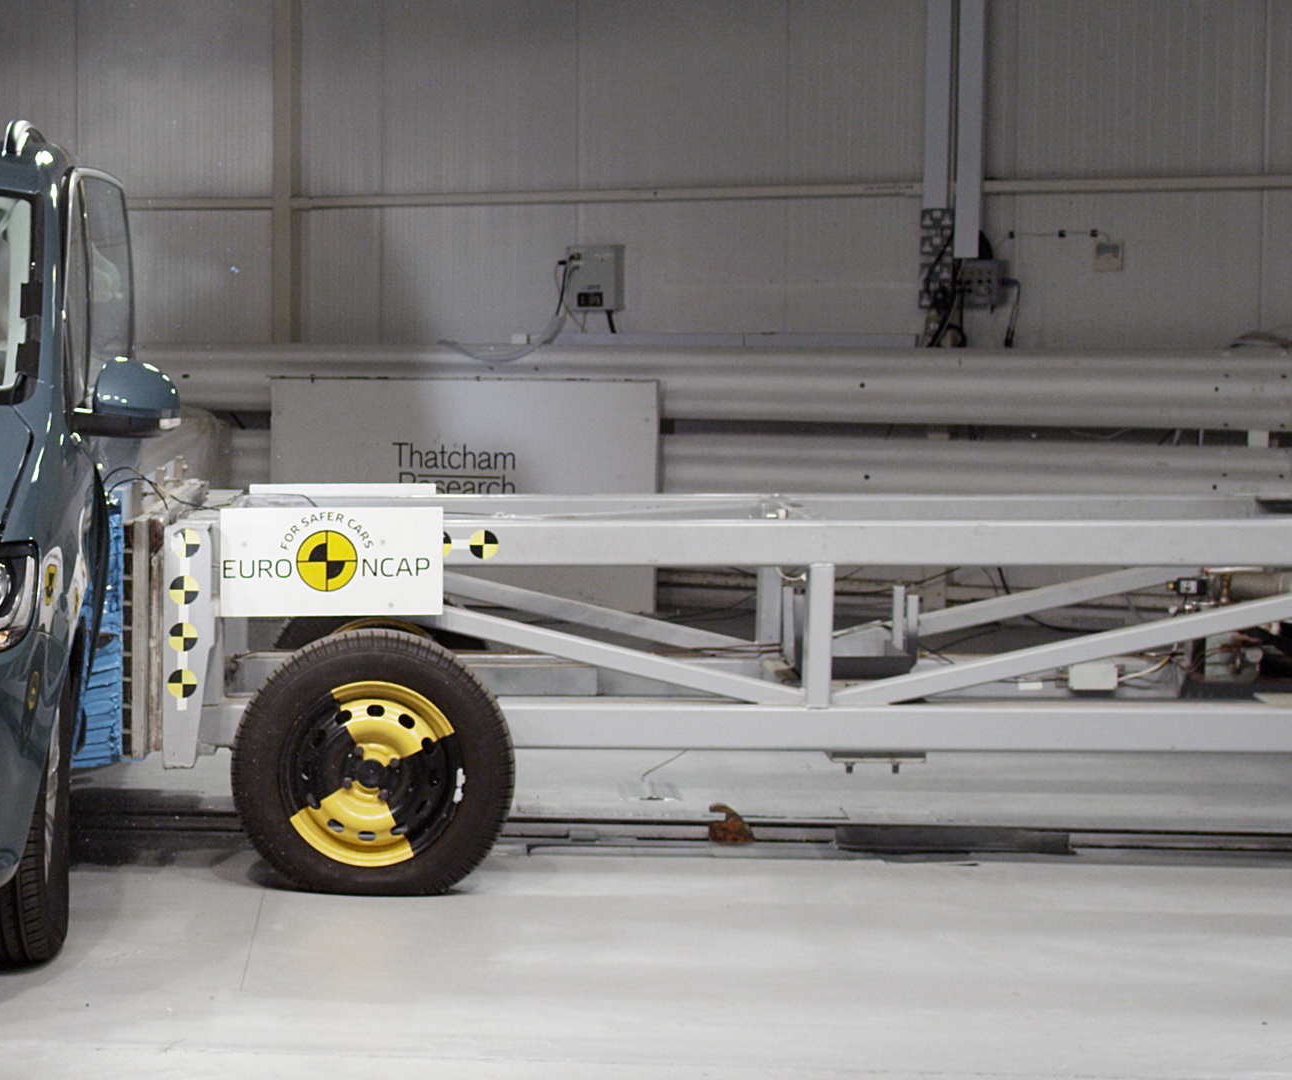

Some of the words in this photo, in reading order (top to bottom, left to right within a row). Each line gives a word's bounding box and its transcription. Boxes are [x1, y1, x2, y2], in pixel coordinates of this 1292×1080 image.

[392, 442, 516, 470] Thatcham
[399, 472, 516, 494] search
[280, 525, 301, 550] FOR
[300, 511, 345, 527] SAFER
[347, 518, 374, 549] CARS
[222, 559, 293, 579] EURO
[361, 557, 430, 577] NCAP
